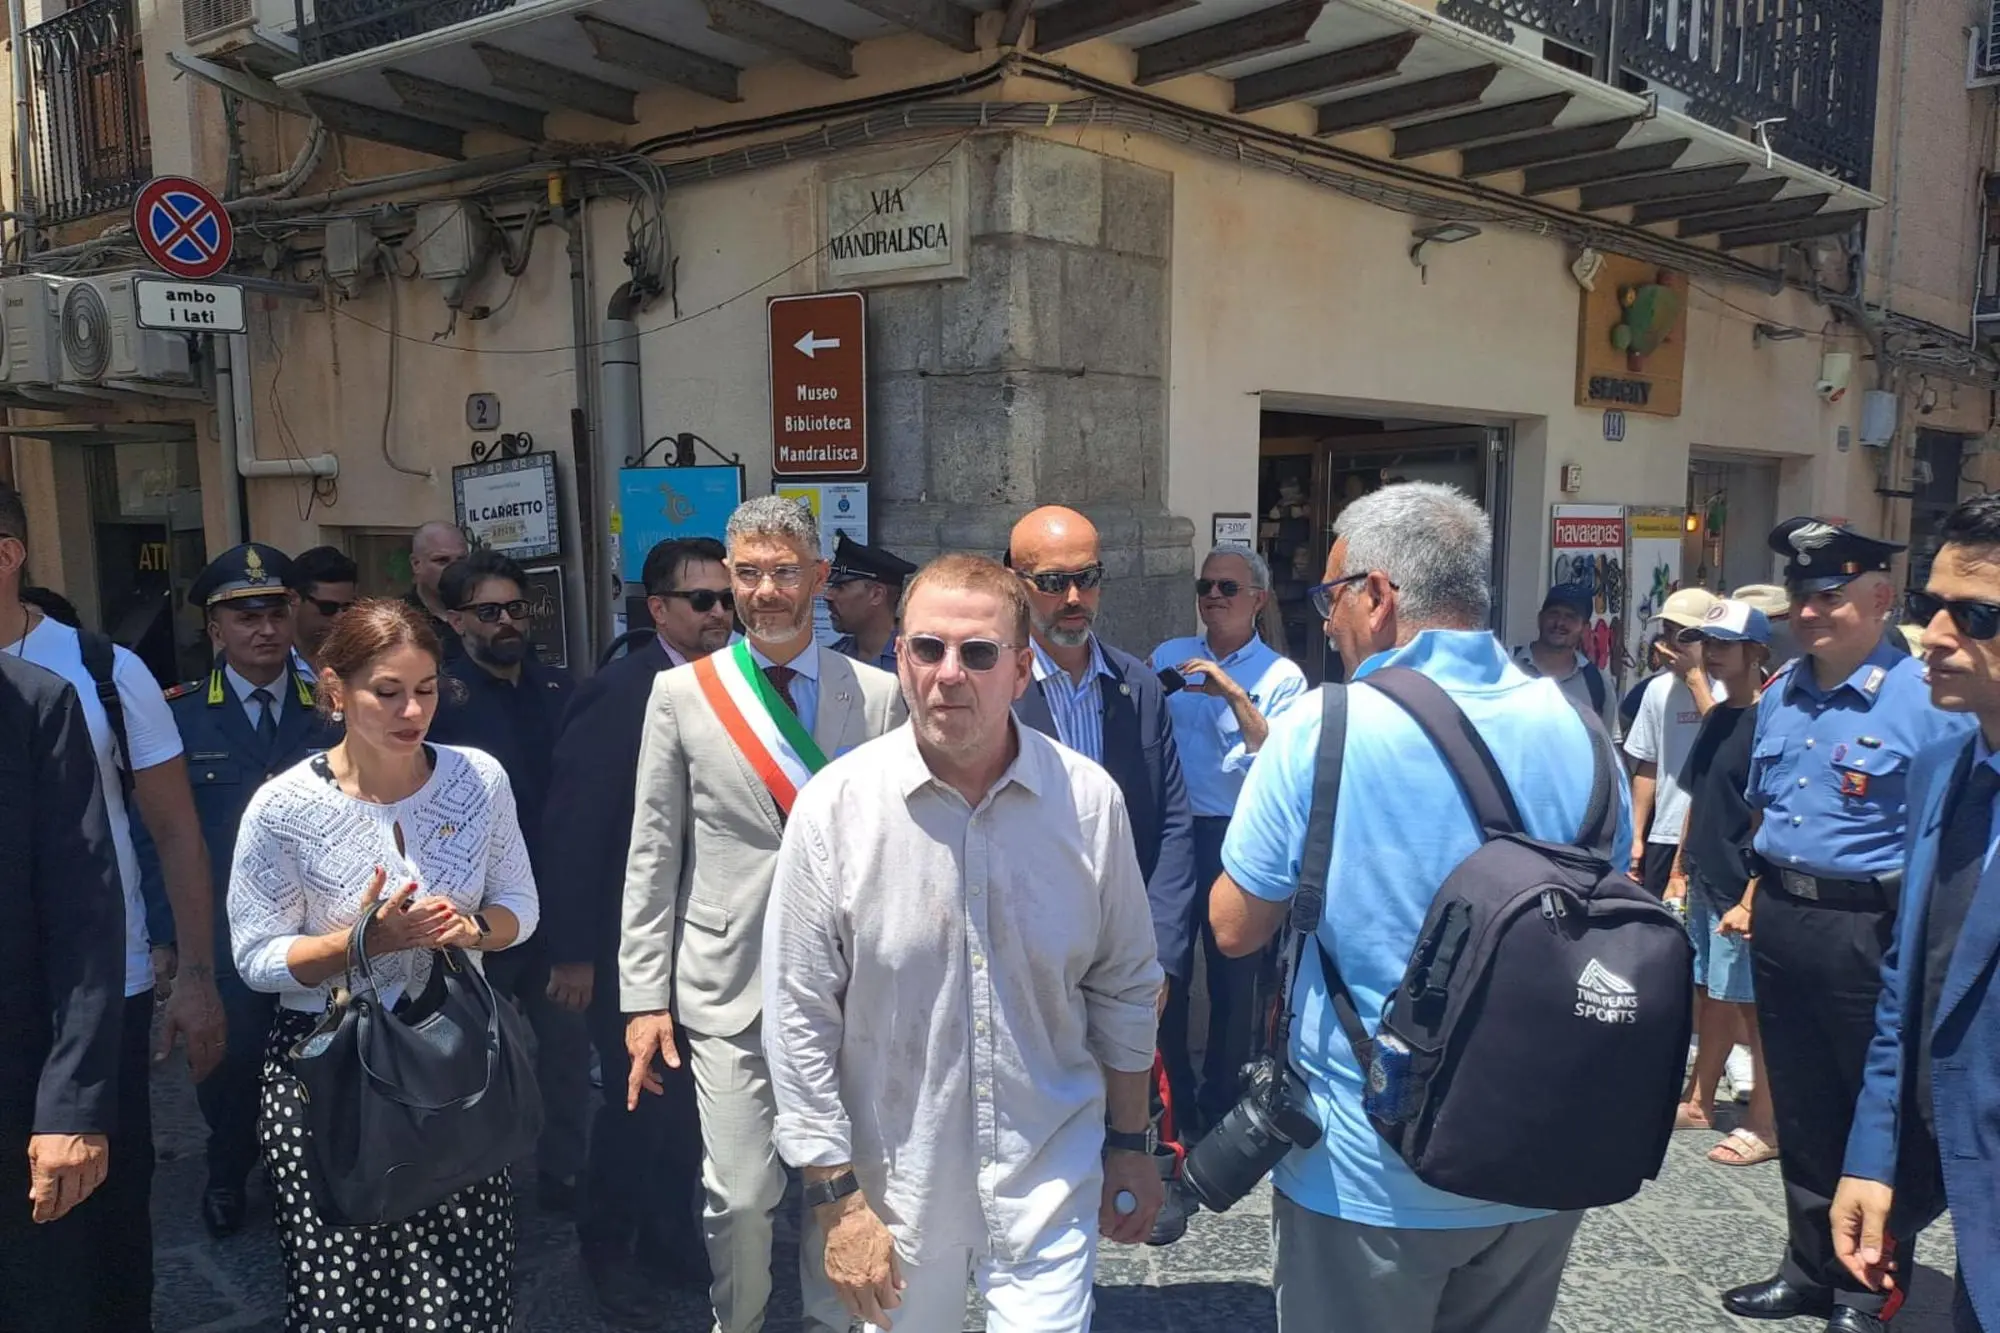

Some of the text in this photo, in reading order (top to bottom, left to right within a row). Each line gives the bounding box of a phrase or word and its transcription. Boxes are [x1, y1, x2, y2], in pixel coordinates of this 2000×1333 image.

[871, 187, 904, 215] VIA
[830, 222, 948, 260] MANDRALISCA
[166, 289, 216, 304] ambo
[170, 308, 215, 324] i lati
[797, 384, 838, 401] Museo
[476, 400, 488, 424] 2
[785, 414, 852, 432] Biblioteca
[780, 444, 858, 462] Mandralisca
[469, 500, 543, 523] IL CARRETTO
[1556, 519, 1620, 545] havaianas
[1601, 996, 1638, 1009] PEAKS
[1573, 1002, 1637, 1023] SPORTS
